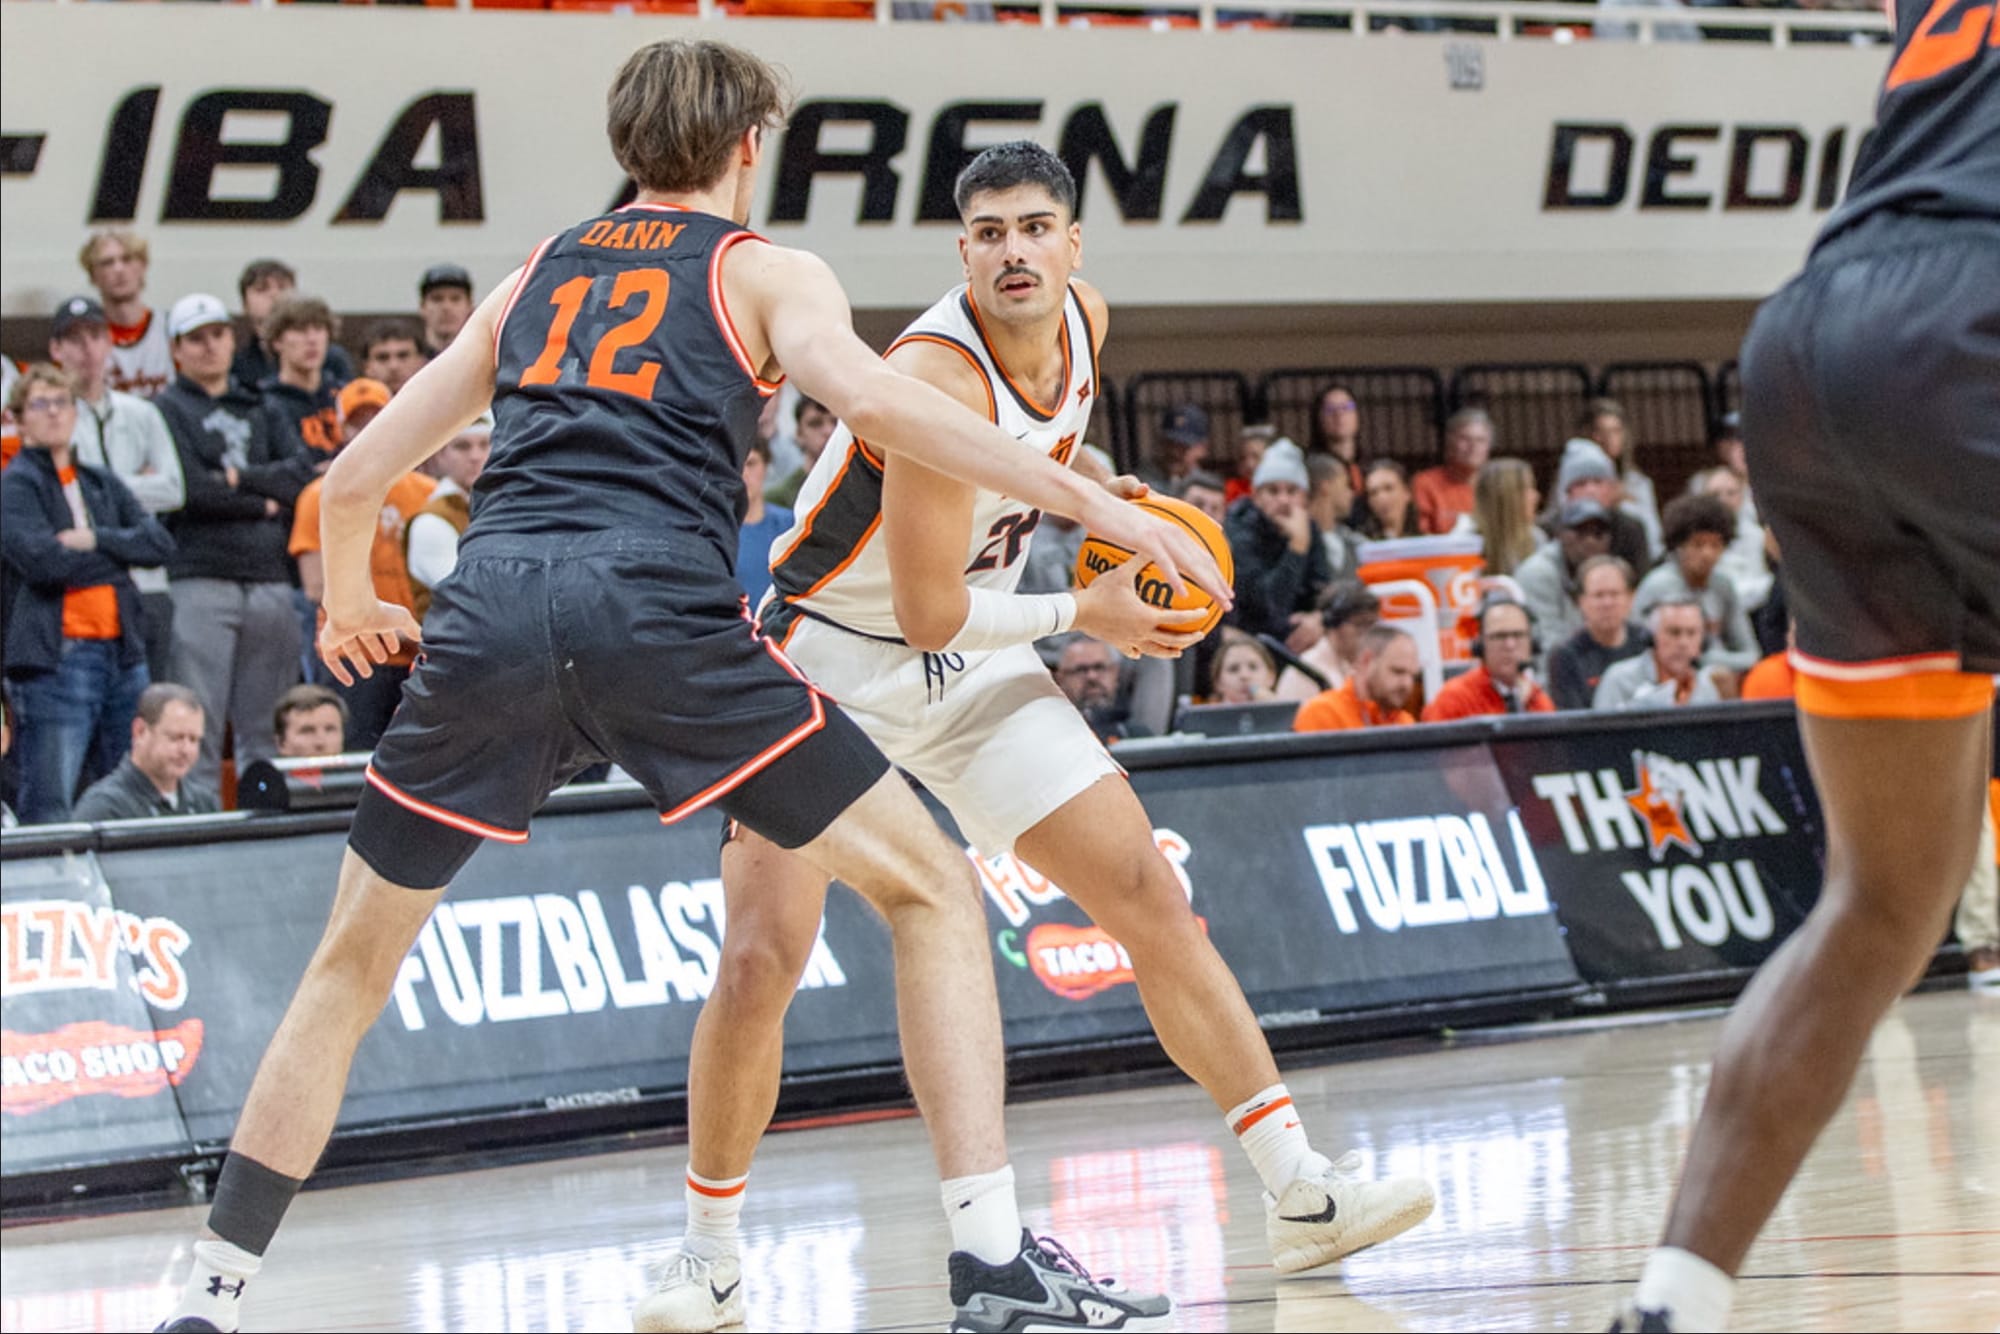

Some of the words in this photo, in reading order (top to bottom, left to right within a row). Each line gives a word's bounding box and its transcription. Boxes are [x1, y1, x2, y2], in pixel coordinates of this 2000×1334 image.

[604, 97, 1306, 224] RENA
[1541, 122, 1872, 212] DEDI
[578, 220, 688, 250] DANN
[518, 268, 670, 401] 12
[1085, 549, 1174, 609] Won
[1531, 751, 1788, 858] THNK
[1621, 859, 1775, 950] YOU
[393, 878, 848, 1031] FUZZBLAS
[1037, 941, 1118, 976] TACO
[81, 1039, 185, 1078] SHOP
